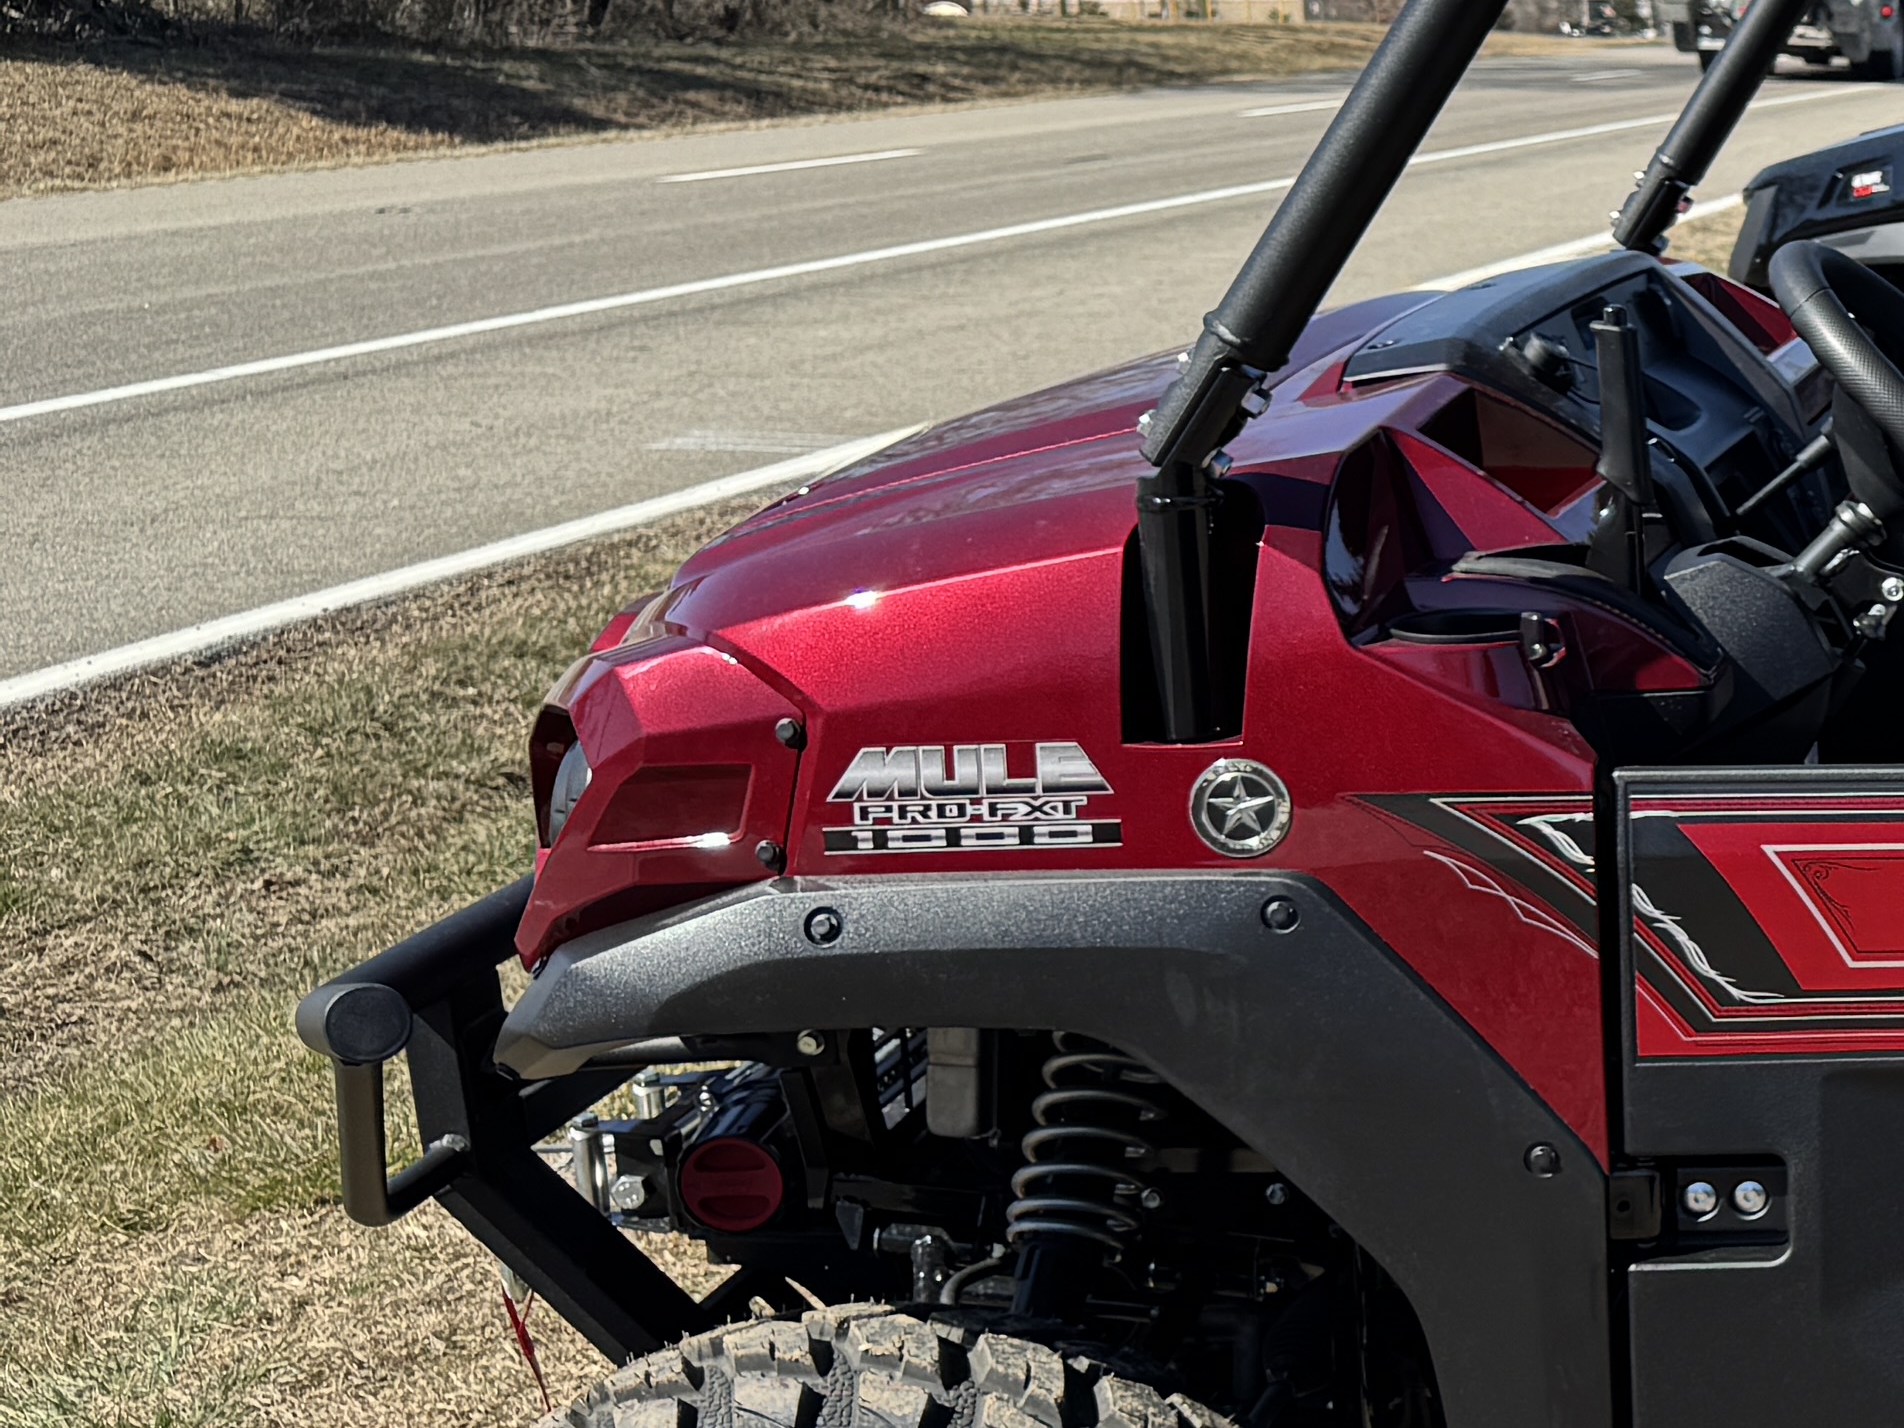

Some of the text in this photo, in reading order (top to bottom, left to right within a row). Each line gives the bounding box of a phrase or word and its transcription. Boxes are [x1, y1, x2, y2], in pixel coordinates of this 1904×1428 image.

[826, 741, 1115, 802] MULE
[853, 795, 1088, 824] PRO-FXT
[851, 824, 1093, 850] 1000
